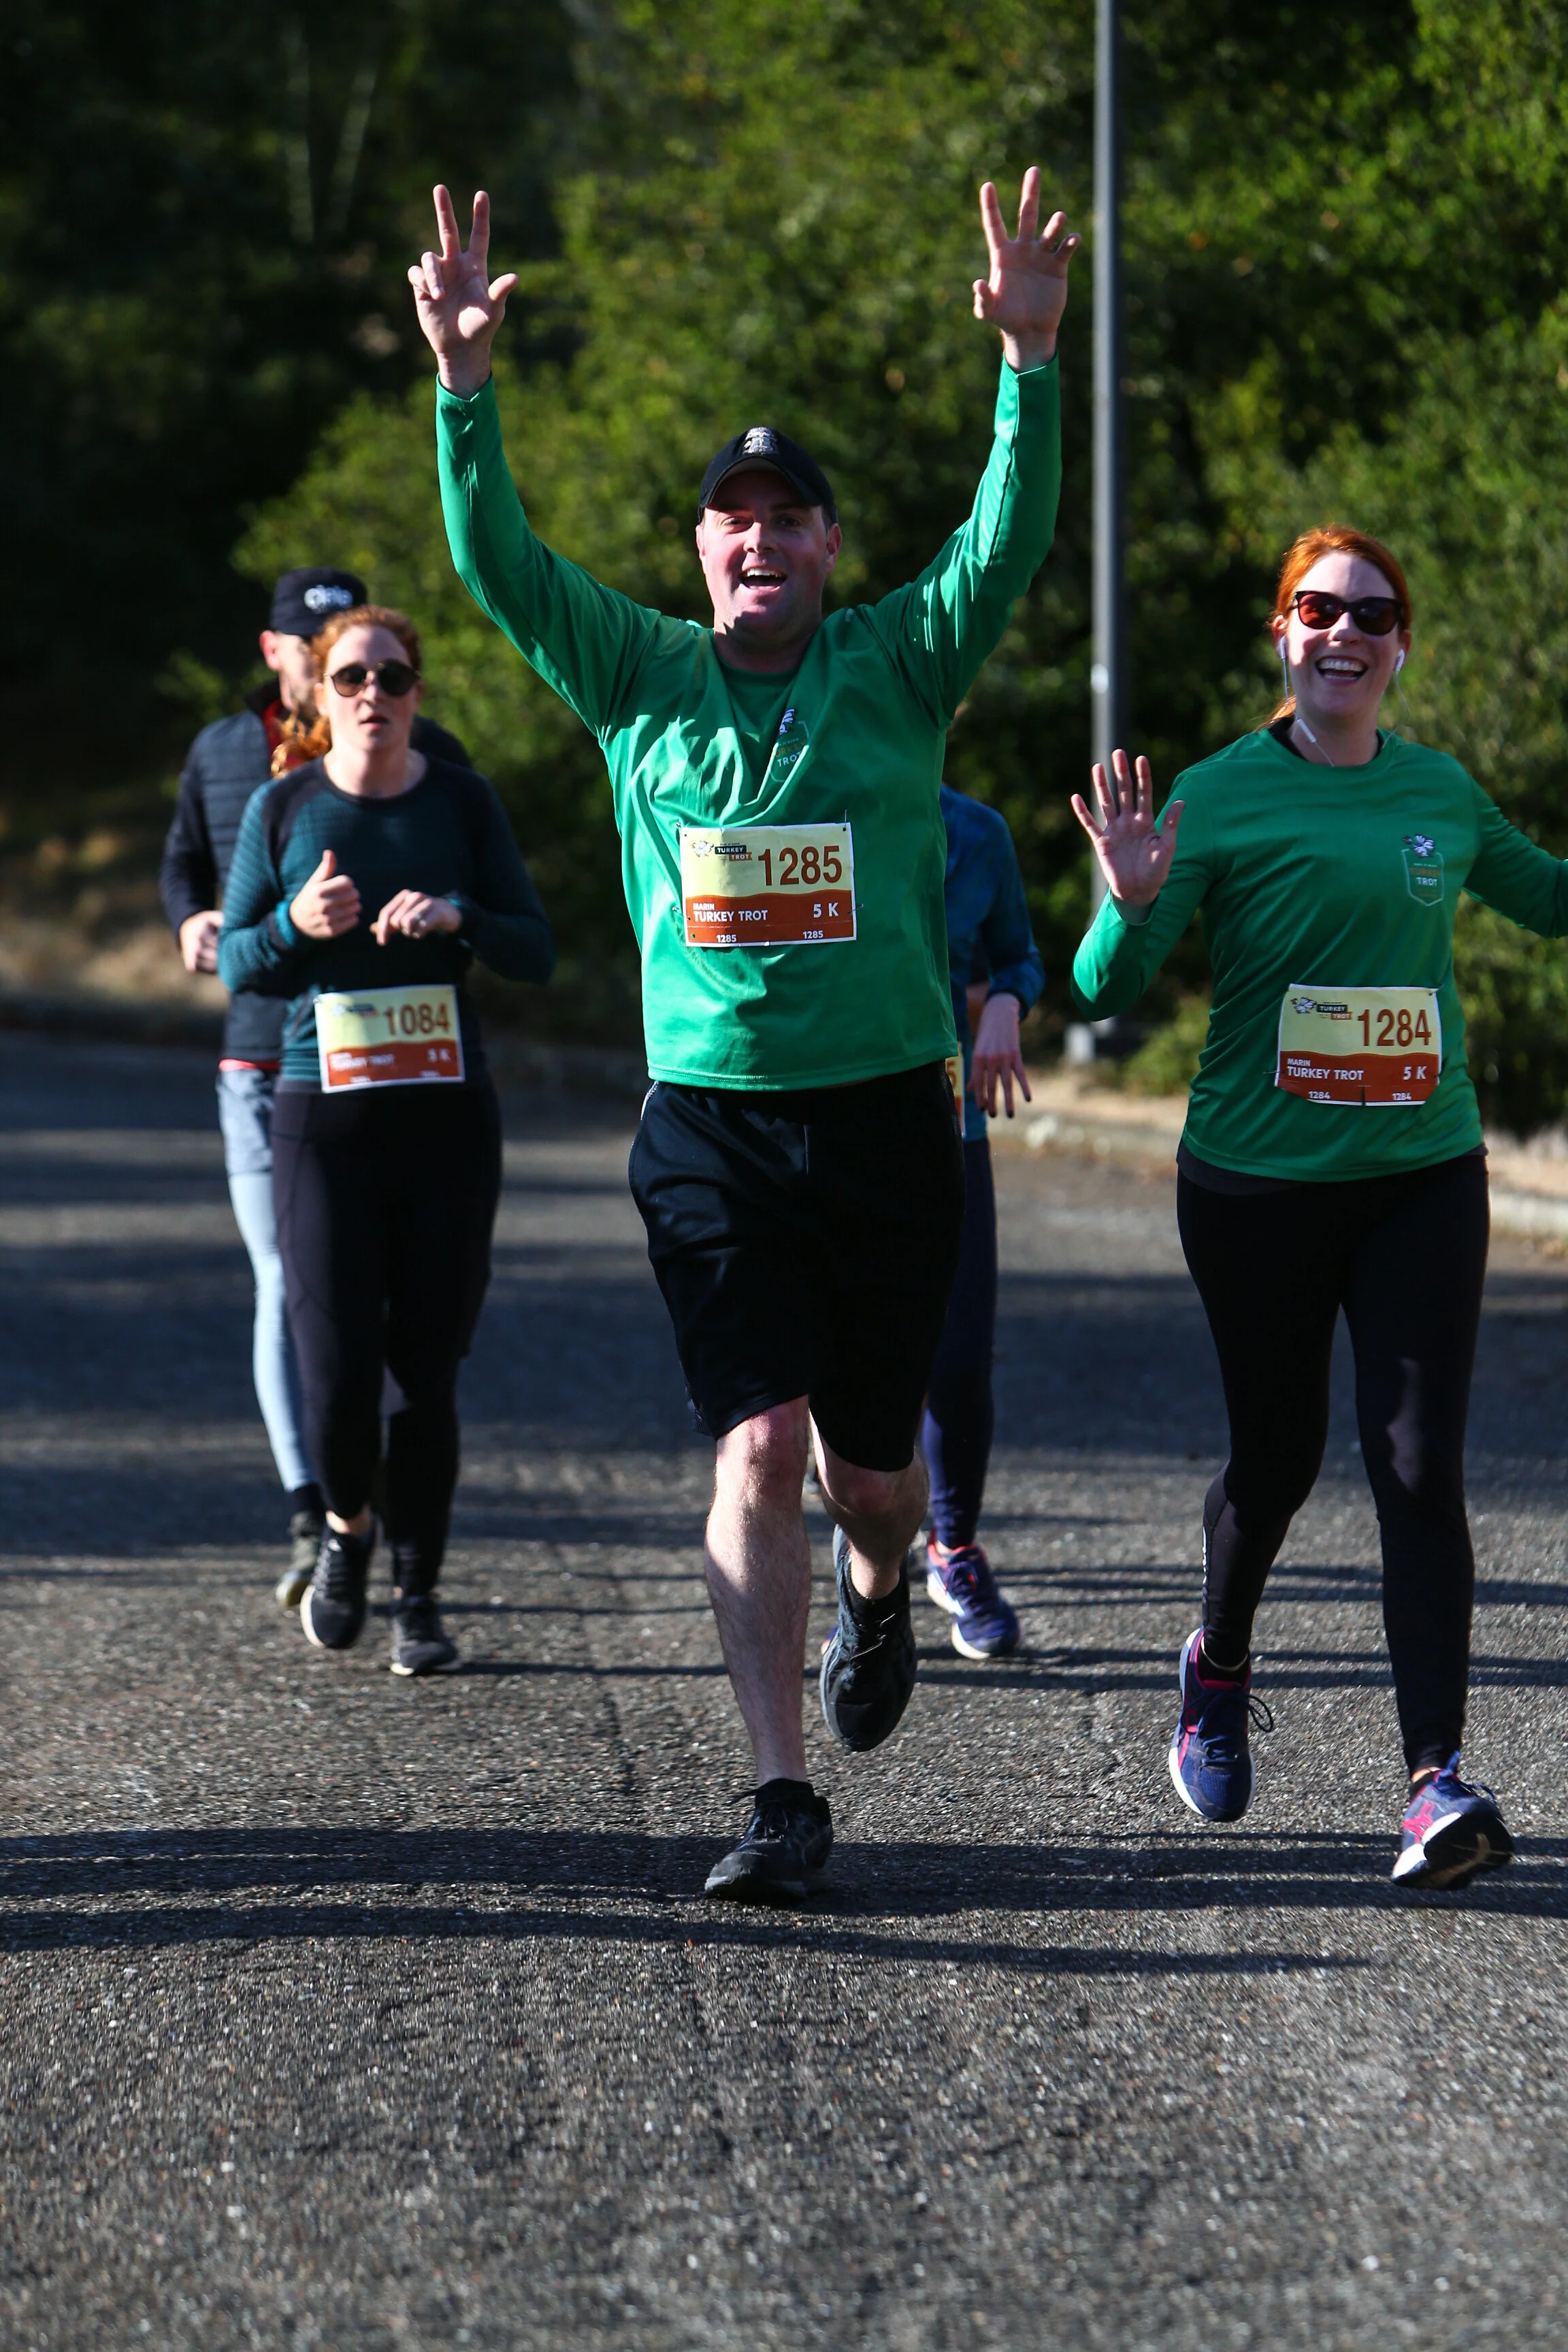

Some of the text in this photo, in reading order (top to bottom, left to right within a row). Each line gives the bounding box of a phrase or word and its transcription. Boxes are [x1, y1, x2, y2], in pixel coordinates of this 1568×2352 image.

[757, 845, 843, 886] 1285
[693, 910, 768, 922] TURKEY TROT
[813, 902, 839, 918] 5 K
[716, 934, 737, 943] 1285
[802, 930, 823, 939] 1285
[383, 1002, 451, 1035] 1084
[1357, 1009, 1432, 1047] 1284
[1287, 1058, 1311, 1066] MARIN
[1287, 1066, 1364, 1081] TURKEY TROT
[1403, 1066, 1428, 1081] 5 K
[1308, 1090, 1330, 1100] 1284
[1392, 1092, 1412, 1100] 1284
